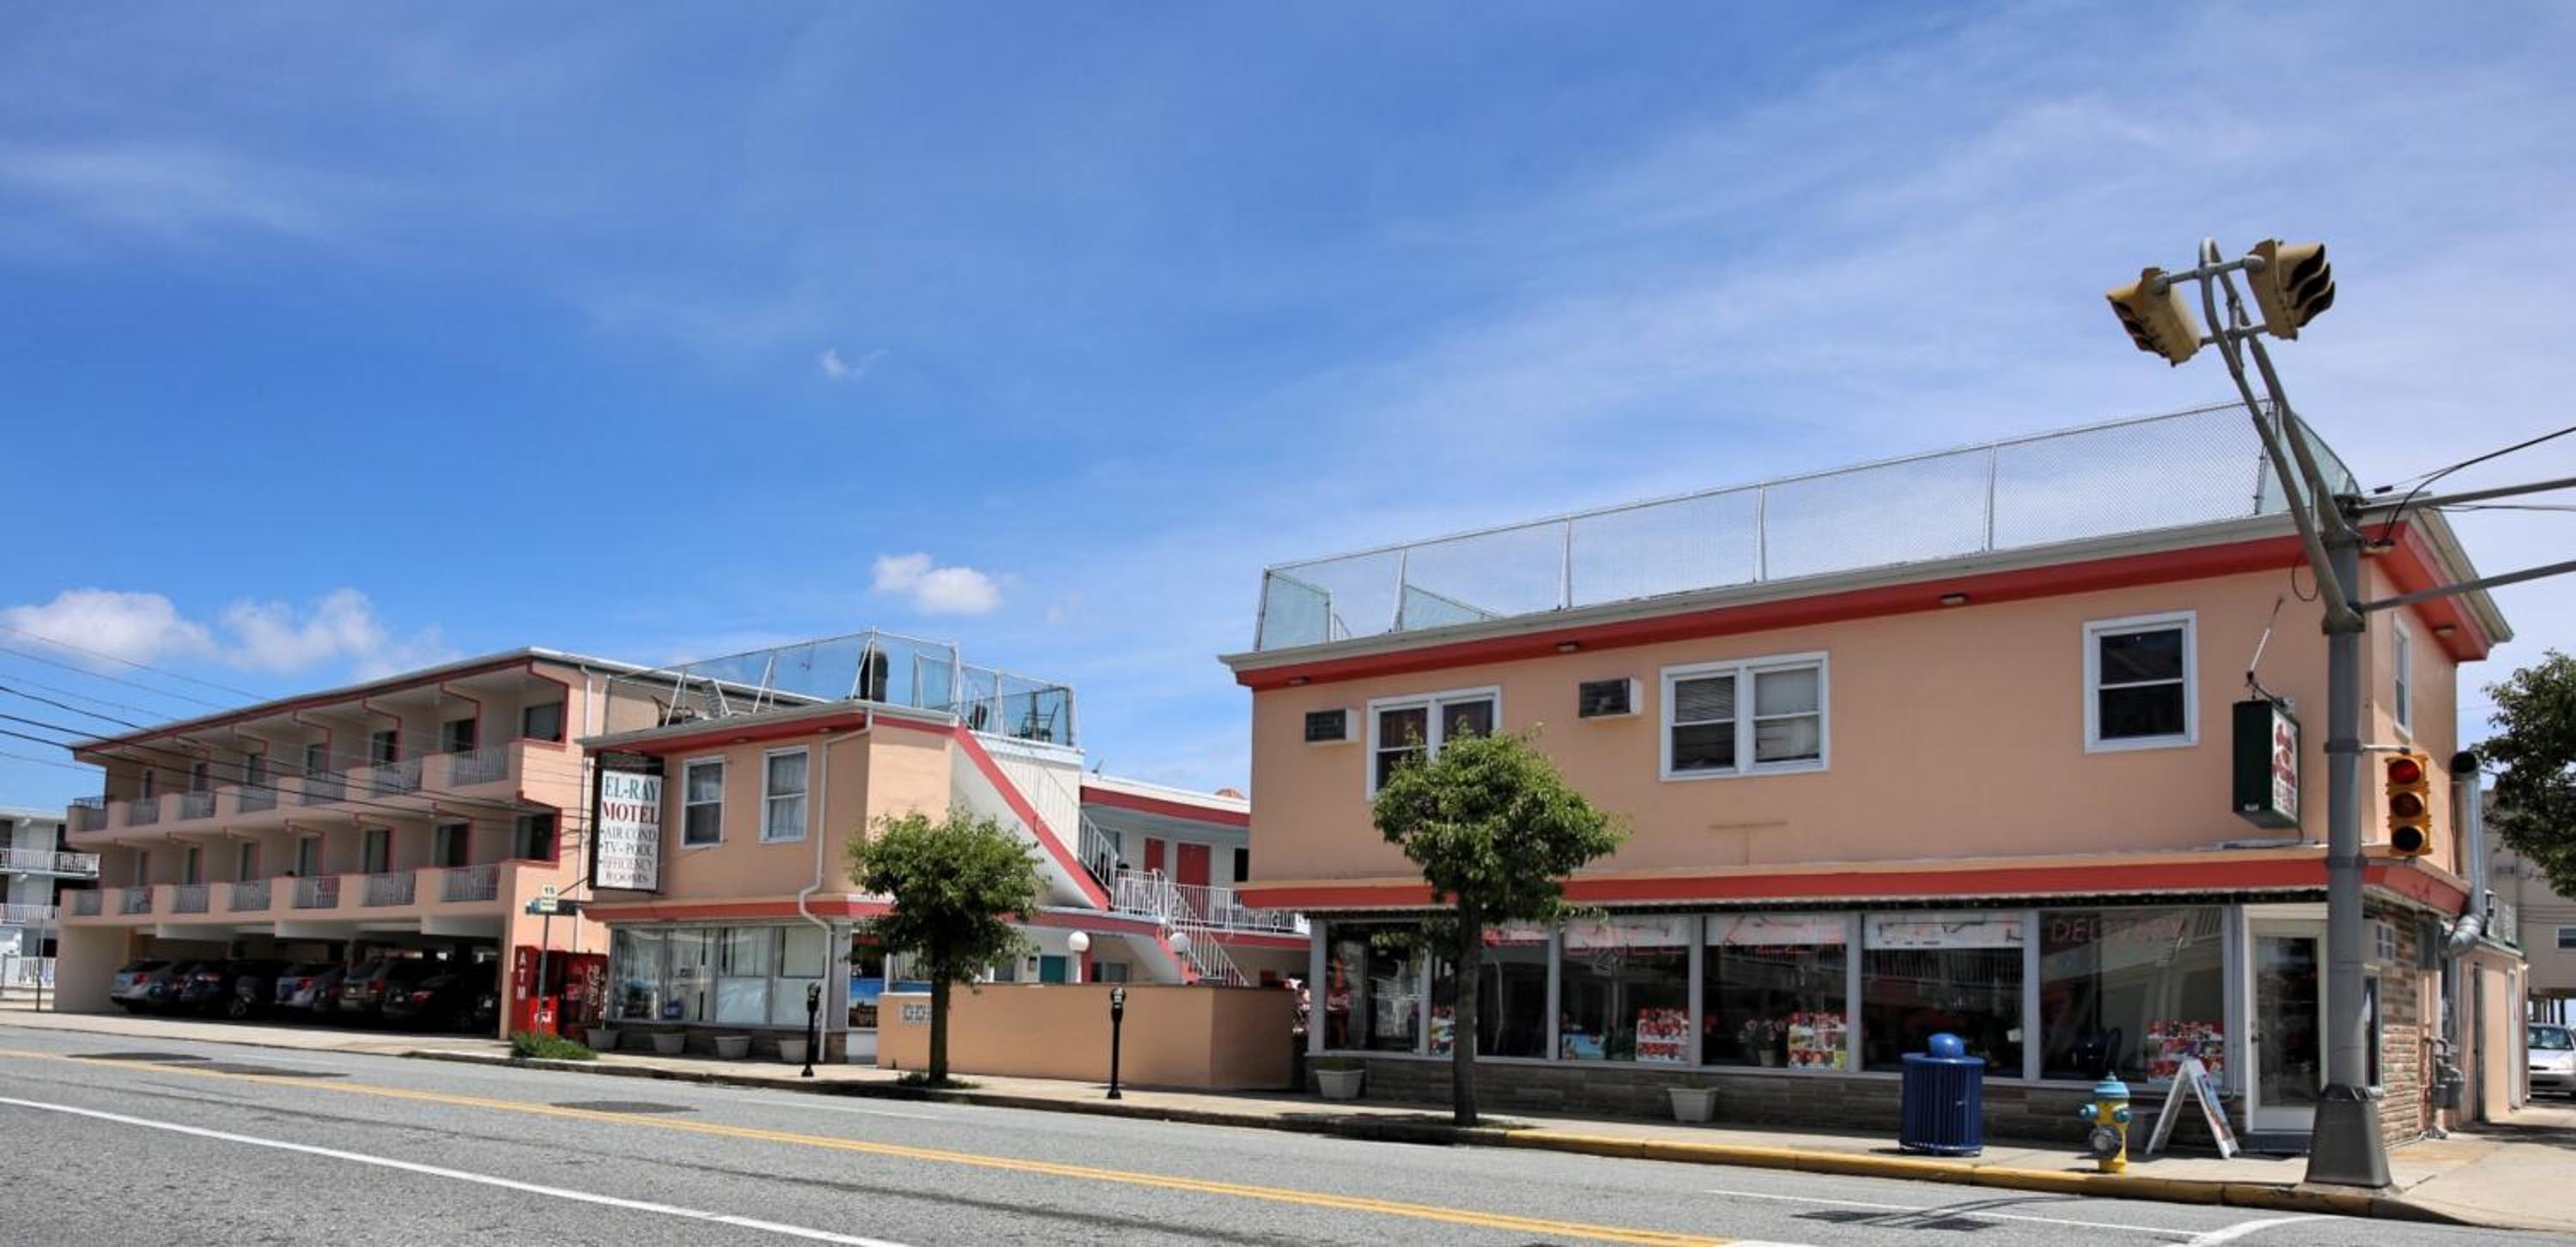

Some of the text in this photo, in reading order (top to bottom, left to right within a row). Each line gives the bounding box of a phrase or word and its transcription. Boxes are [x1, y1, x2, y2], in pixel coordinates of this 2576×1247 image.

[605, 776, 659, 801] EL-RAY
[603, 801, 659, 824] MOTEL
[605, 825, 624, 841] AIR
[605, 841, 617, 854] TV
[626, 842, 654, 856] POOL
[2051, 916, 2187, 943] DELY
[517, 951, 527, 1001] ATM
